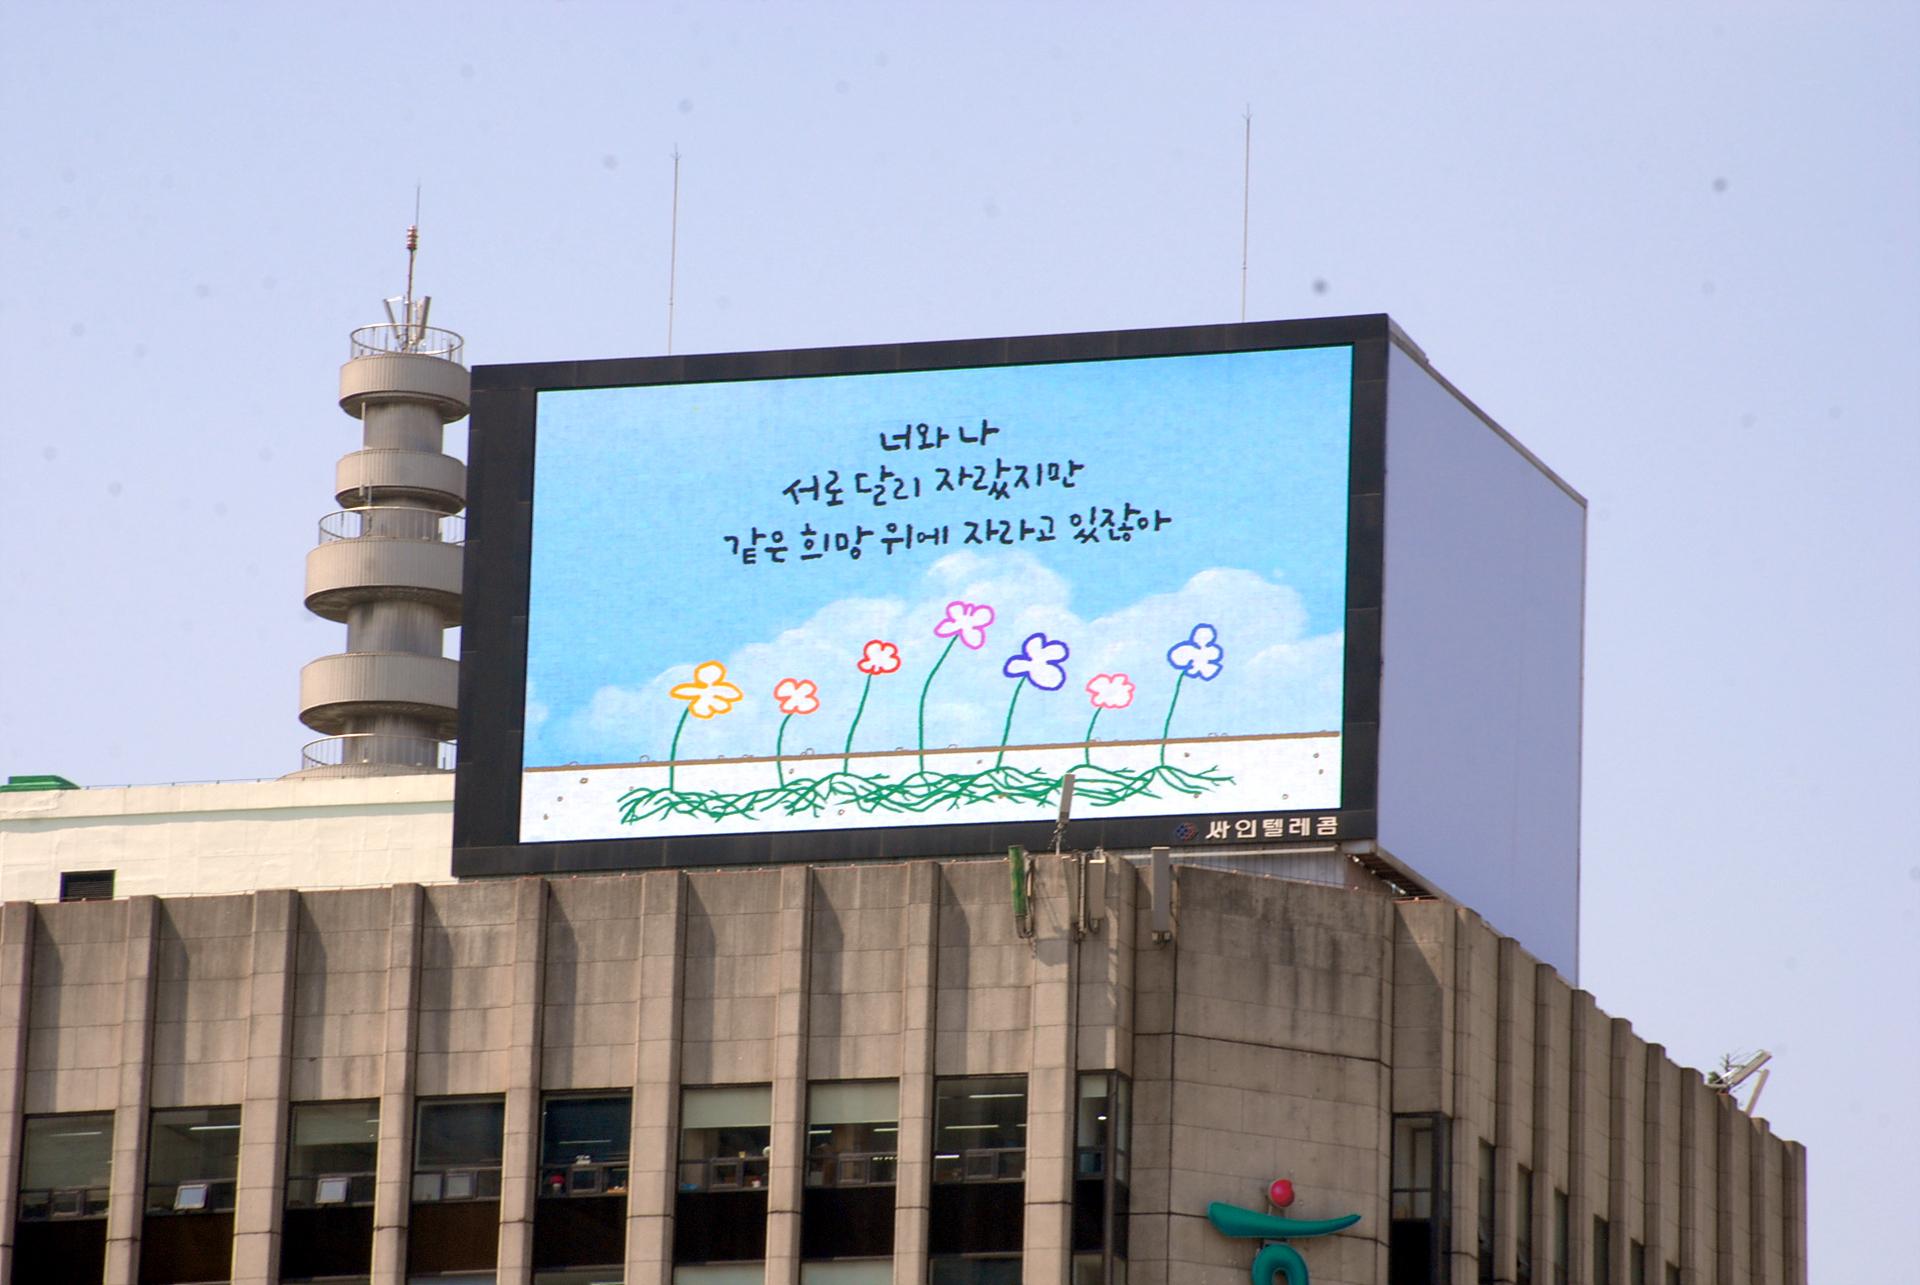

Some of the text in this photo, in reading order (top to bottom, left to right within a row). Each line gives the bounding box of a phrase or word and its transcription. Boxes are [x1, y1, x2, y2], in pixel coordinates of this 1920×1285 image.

[880, 420, 999, 451] 너와 나
[783, 458, 1084, 506] 서로 달리 자랐지만
[724, 503, 1171, 564] 같은 희망 위에 자라고 있잖아
[1206, 817, 1337, 838] 싸인텔레콤
